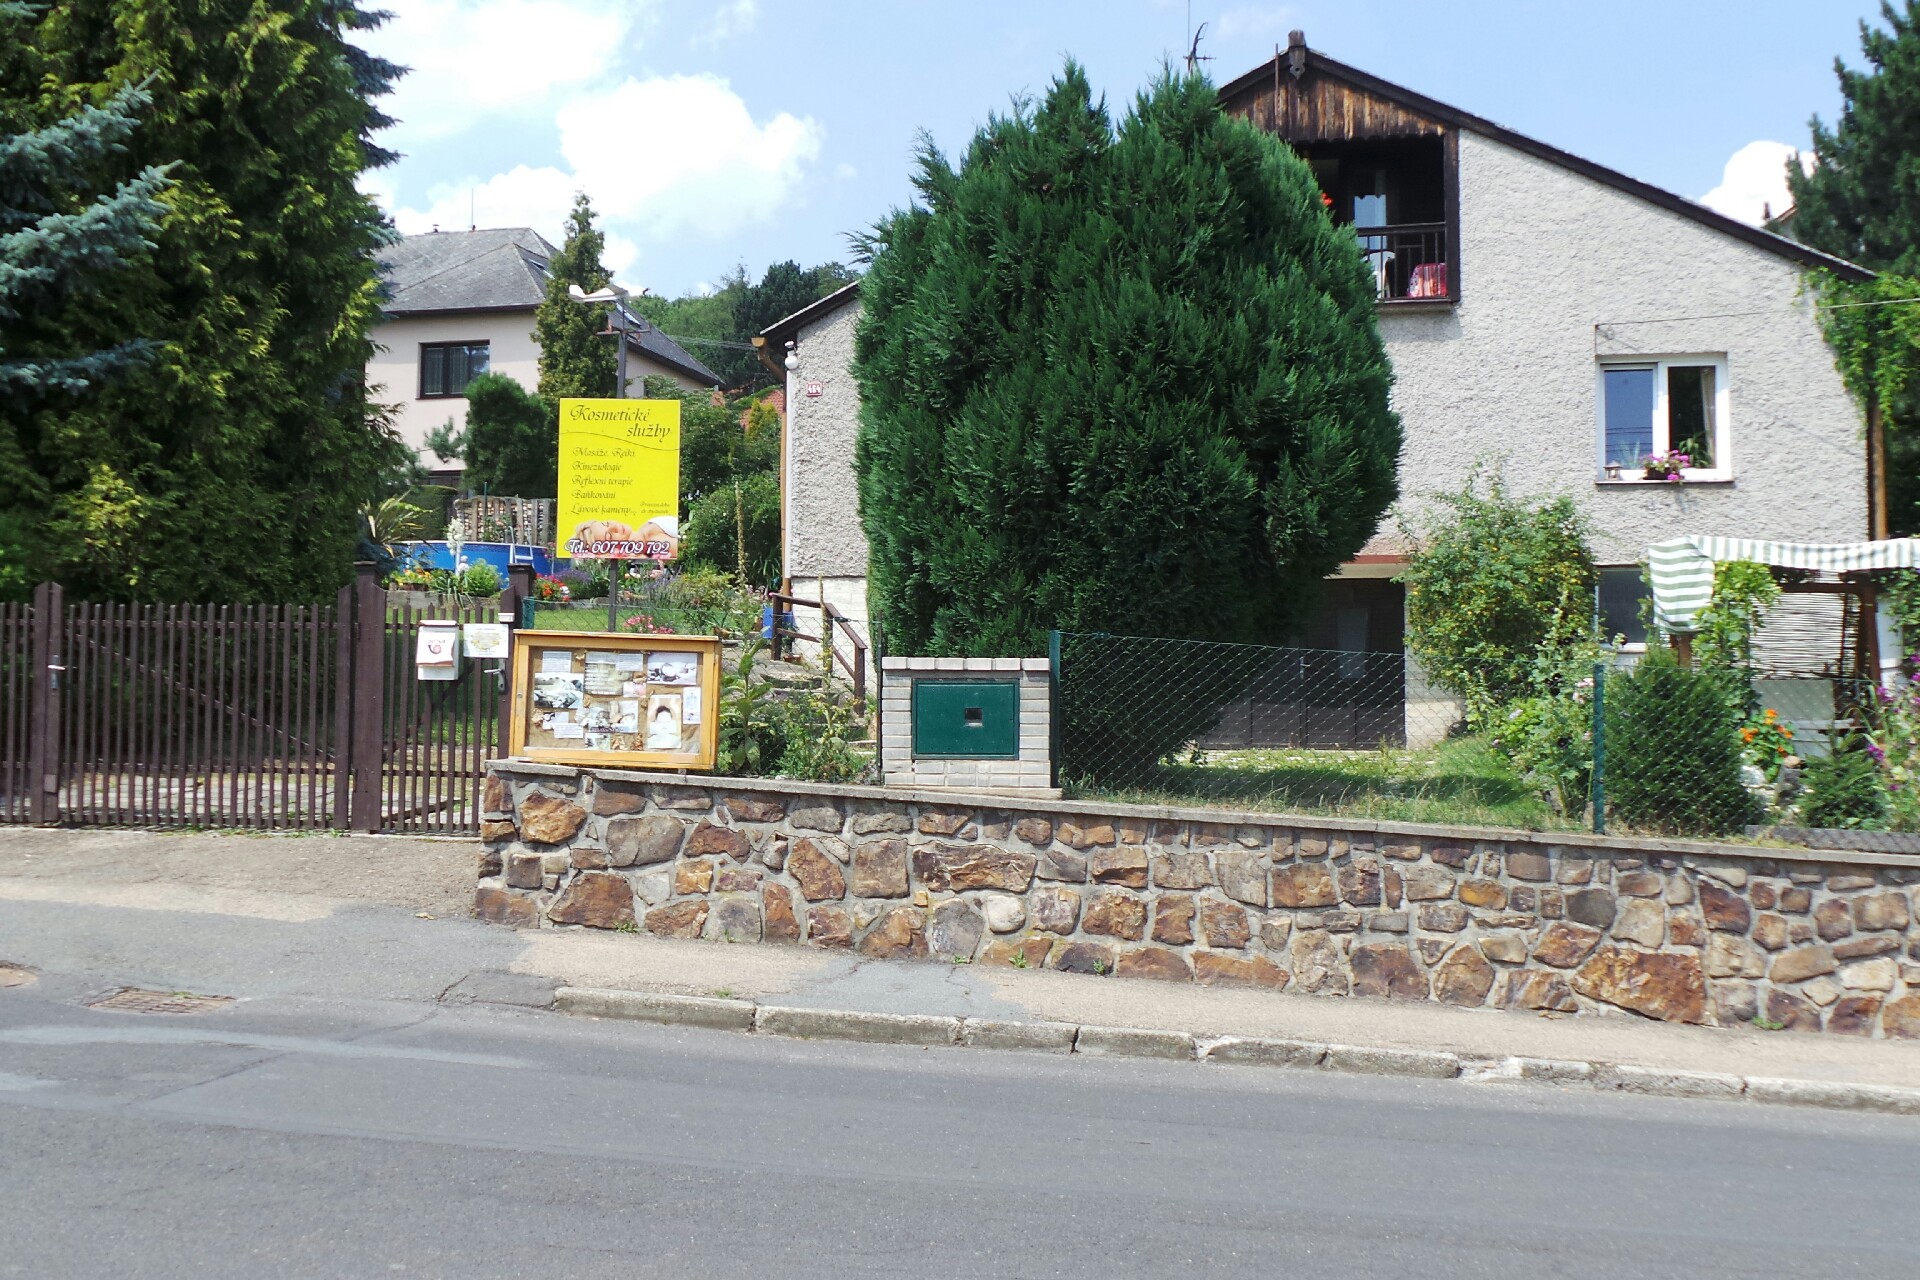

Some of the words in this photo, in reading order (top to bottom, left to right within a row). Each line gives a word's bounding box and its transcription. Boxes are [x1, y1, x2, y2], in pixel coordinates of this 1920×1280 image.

[570, 404, 651, 422] Kosmetické
[627, 423, 671, 443] služby
[572, 460, 623, 473] Kineziologie
[608, 475, 634, 488] terapie
[591, 539, 617, 554] 607
[618, 540, 644, 555] 709
[647, 541, 671, 556] 792
